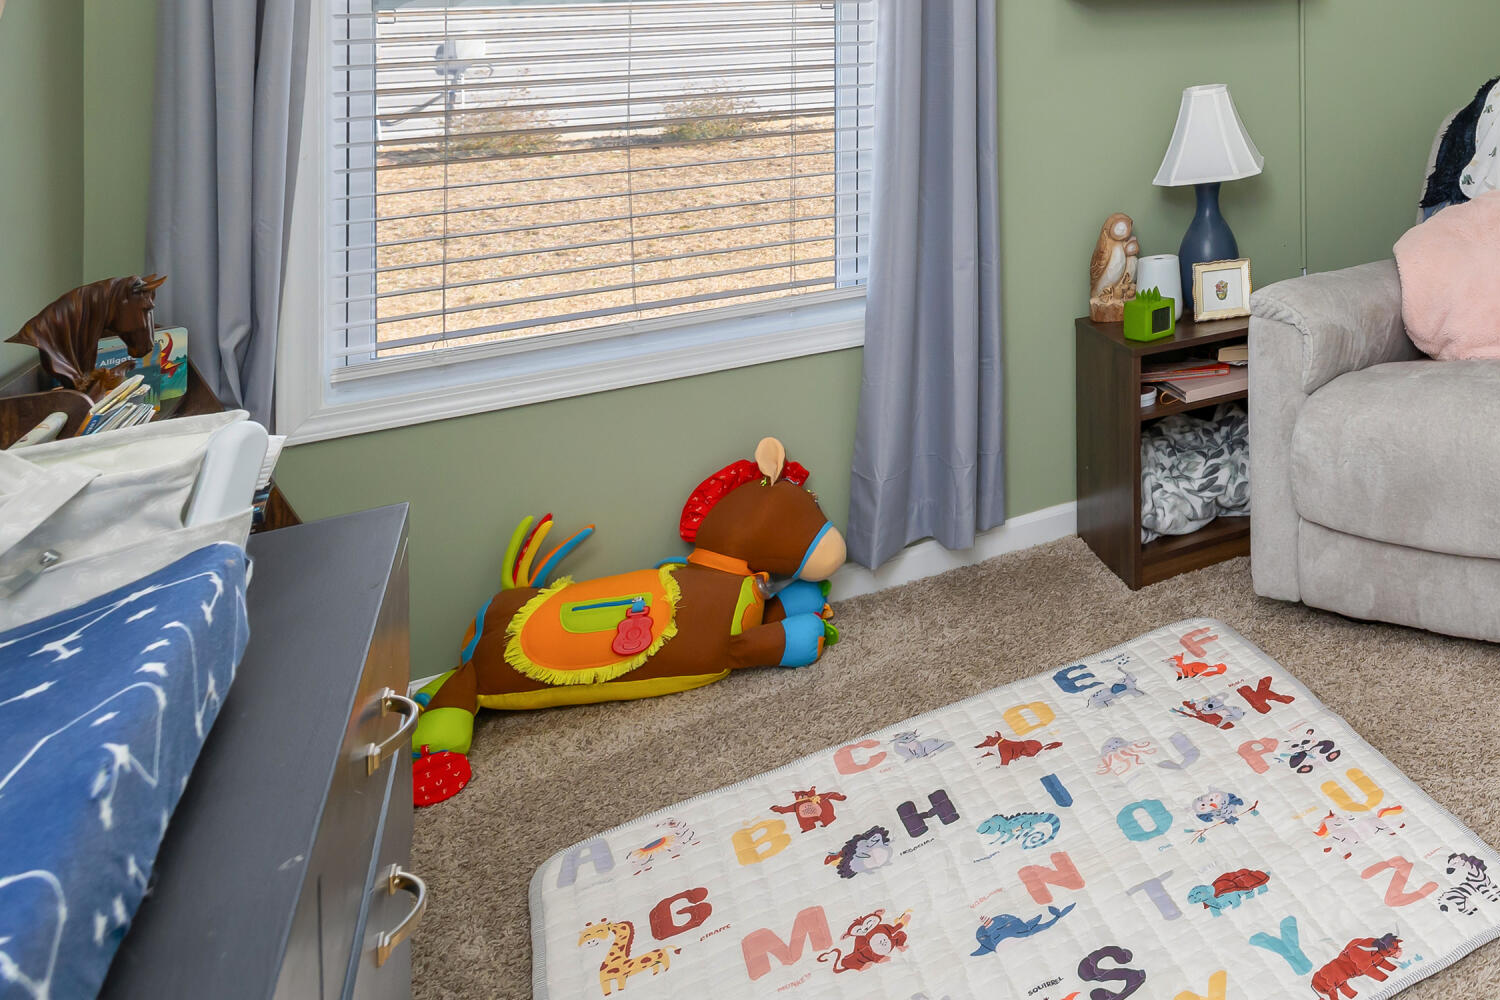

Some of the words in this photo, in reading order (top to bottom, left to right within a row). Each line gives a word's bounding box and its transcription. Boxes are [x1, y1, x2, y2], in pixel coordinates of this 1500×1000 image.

[1180, 626, 1219, 658] F
[1053, 664, 1104, 694] E
[1237, 676, 1295, 714] K
[1003, 701, 1056, 736] D
[833, 738, 887, 776] C
[1157, 731, 1200, 770] J
[1237, 737, 1279, 775] P
[1040, 773, 1073, 808] I
[1320, 768, 1384, 812] U
[896, 789, 960, 838] H
[1116, 799, 1173, 842] O
[557, 838, 615, 889] A
[732, 818, 791, 866] B
[1017, 851, 1085, 905] N
[1125, 870, 1183, 921] T
[1361, 855, 1439, 908] Z
[649, 887, 713, 941] G
[741, 905, 834, 981] M
[1249, 915, 1313, 976] Y
[1027, 976, 1064, 997] SQUIRREL
[1077, 945, 1146, 1000] S
